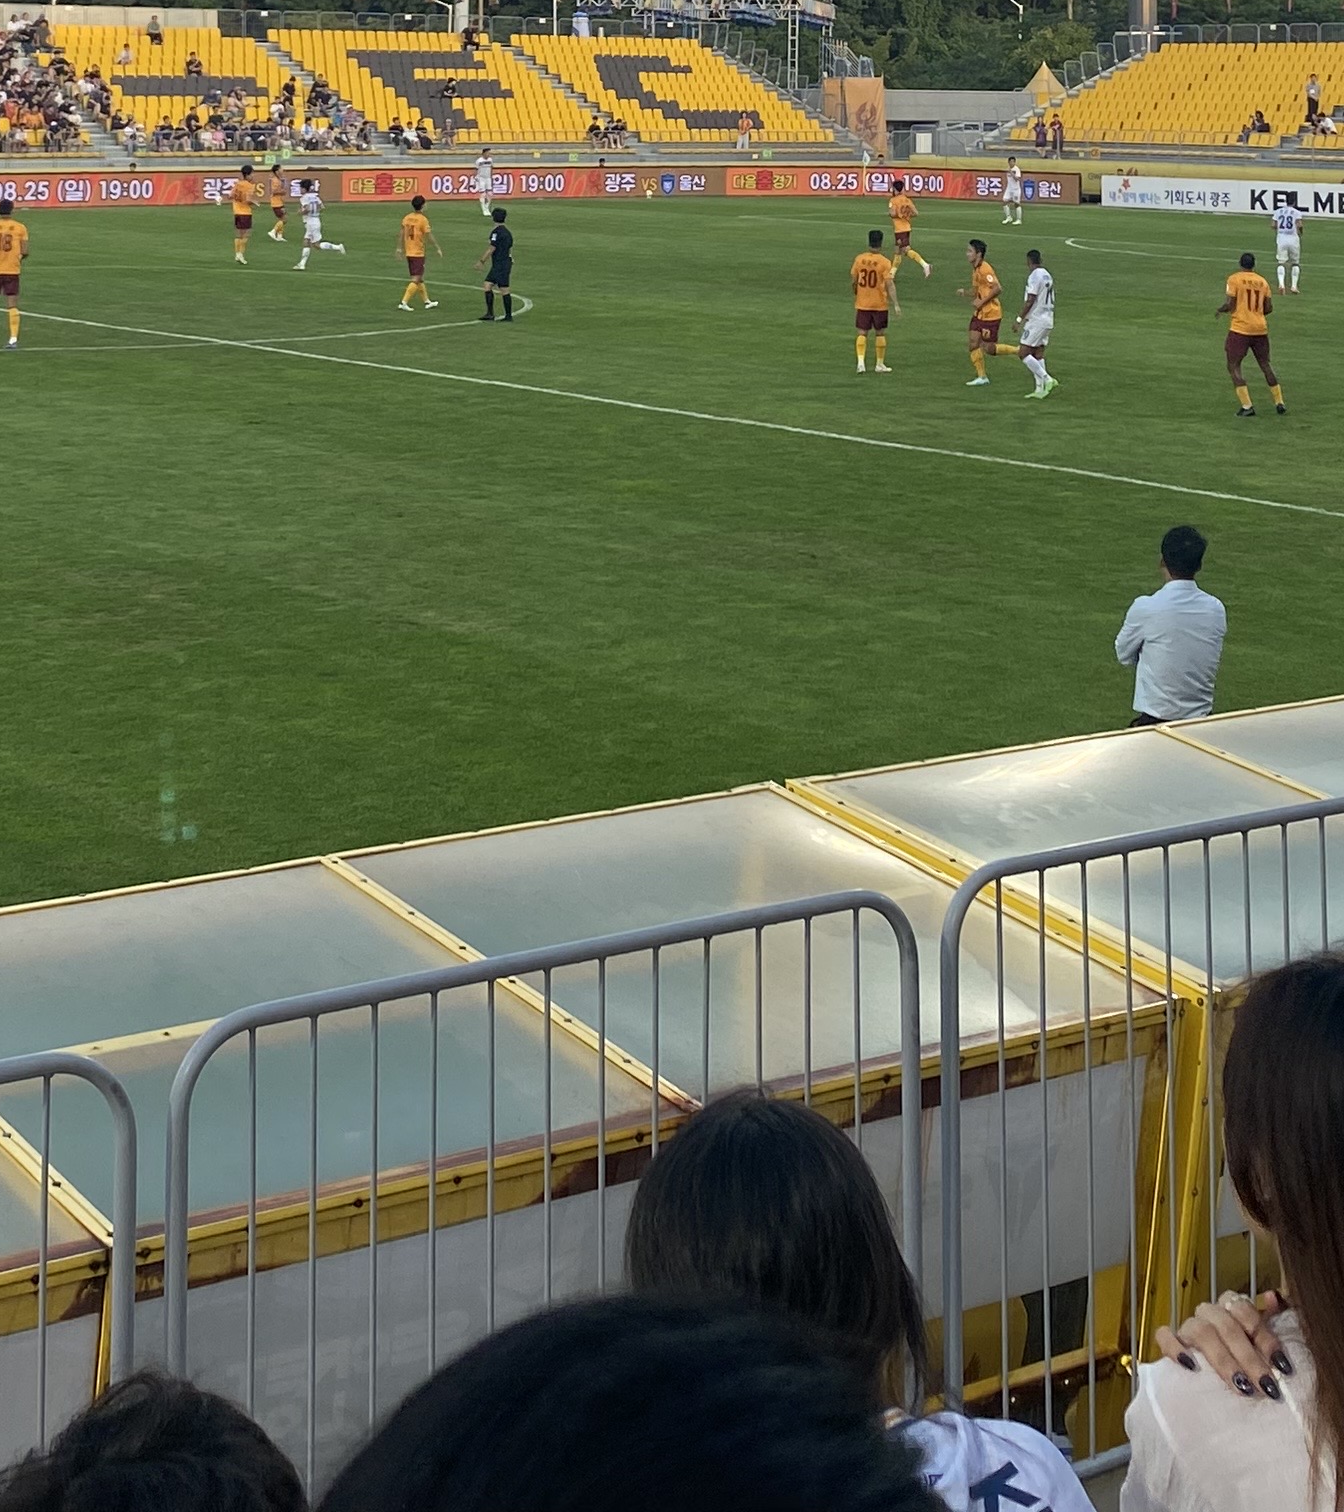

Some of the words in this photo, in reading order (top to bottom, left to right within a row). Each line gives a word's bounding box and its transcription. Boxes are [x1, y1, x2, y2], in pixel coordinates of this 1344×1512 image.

[57, 178, 92, 202] (일)
[99, 178, 154, 200] 19:00
[520, 172, 565, 193] 19:00
[605, 173, 637, 192] 광주
[641, 177, 657, 192] VS
[679, 174, 706, 192] 울산
[809, 172, 858, 191] 08.25
[903, 173, 944, 193] 19:00
[976, 176, 1002, 196] 광주
[1038, 180, 1062, 198] 울산
[1164, 189, 1206, 207] 기회도시
[1209, 191, 1231, 208] 광주
[1278, 215, 1294, 230] 28
[858, 268, 877, 288] 30
[1246, 289, 1260, 313] 11
